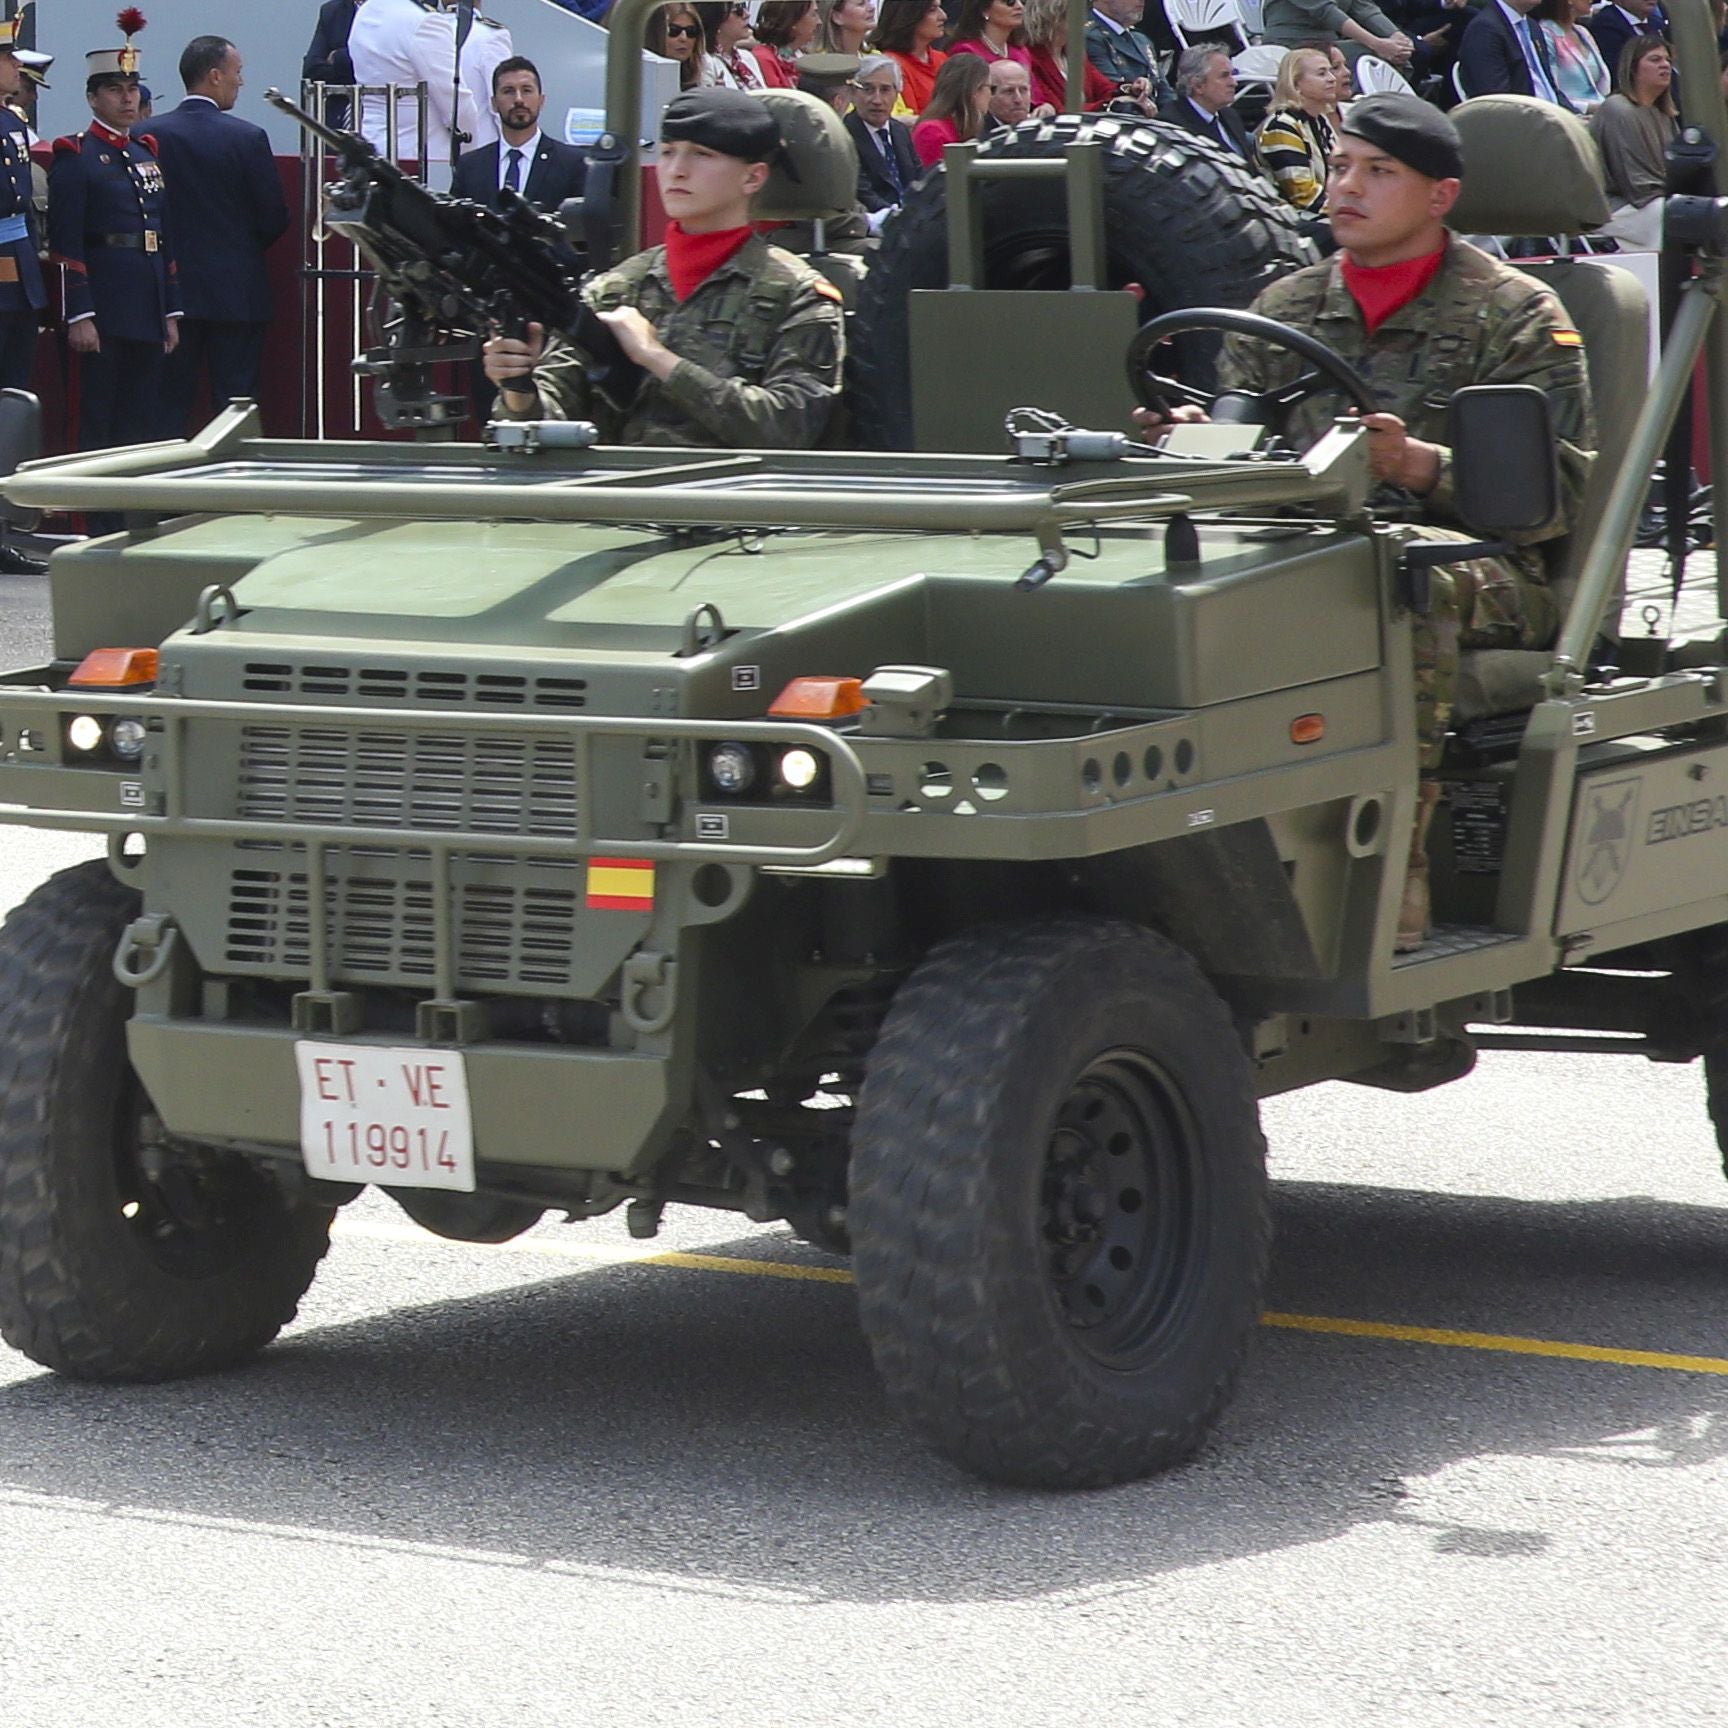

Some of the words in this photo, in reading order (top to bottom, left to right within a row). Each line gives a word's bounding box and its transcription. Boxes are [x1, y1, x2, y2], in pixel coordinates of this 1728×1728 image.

[314, 1058, 355, 1102] ET
[402, 1064, 450, 1109] VE
[323, 1120, 457, 1173] 119914
